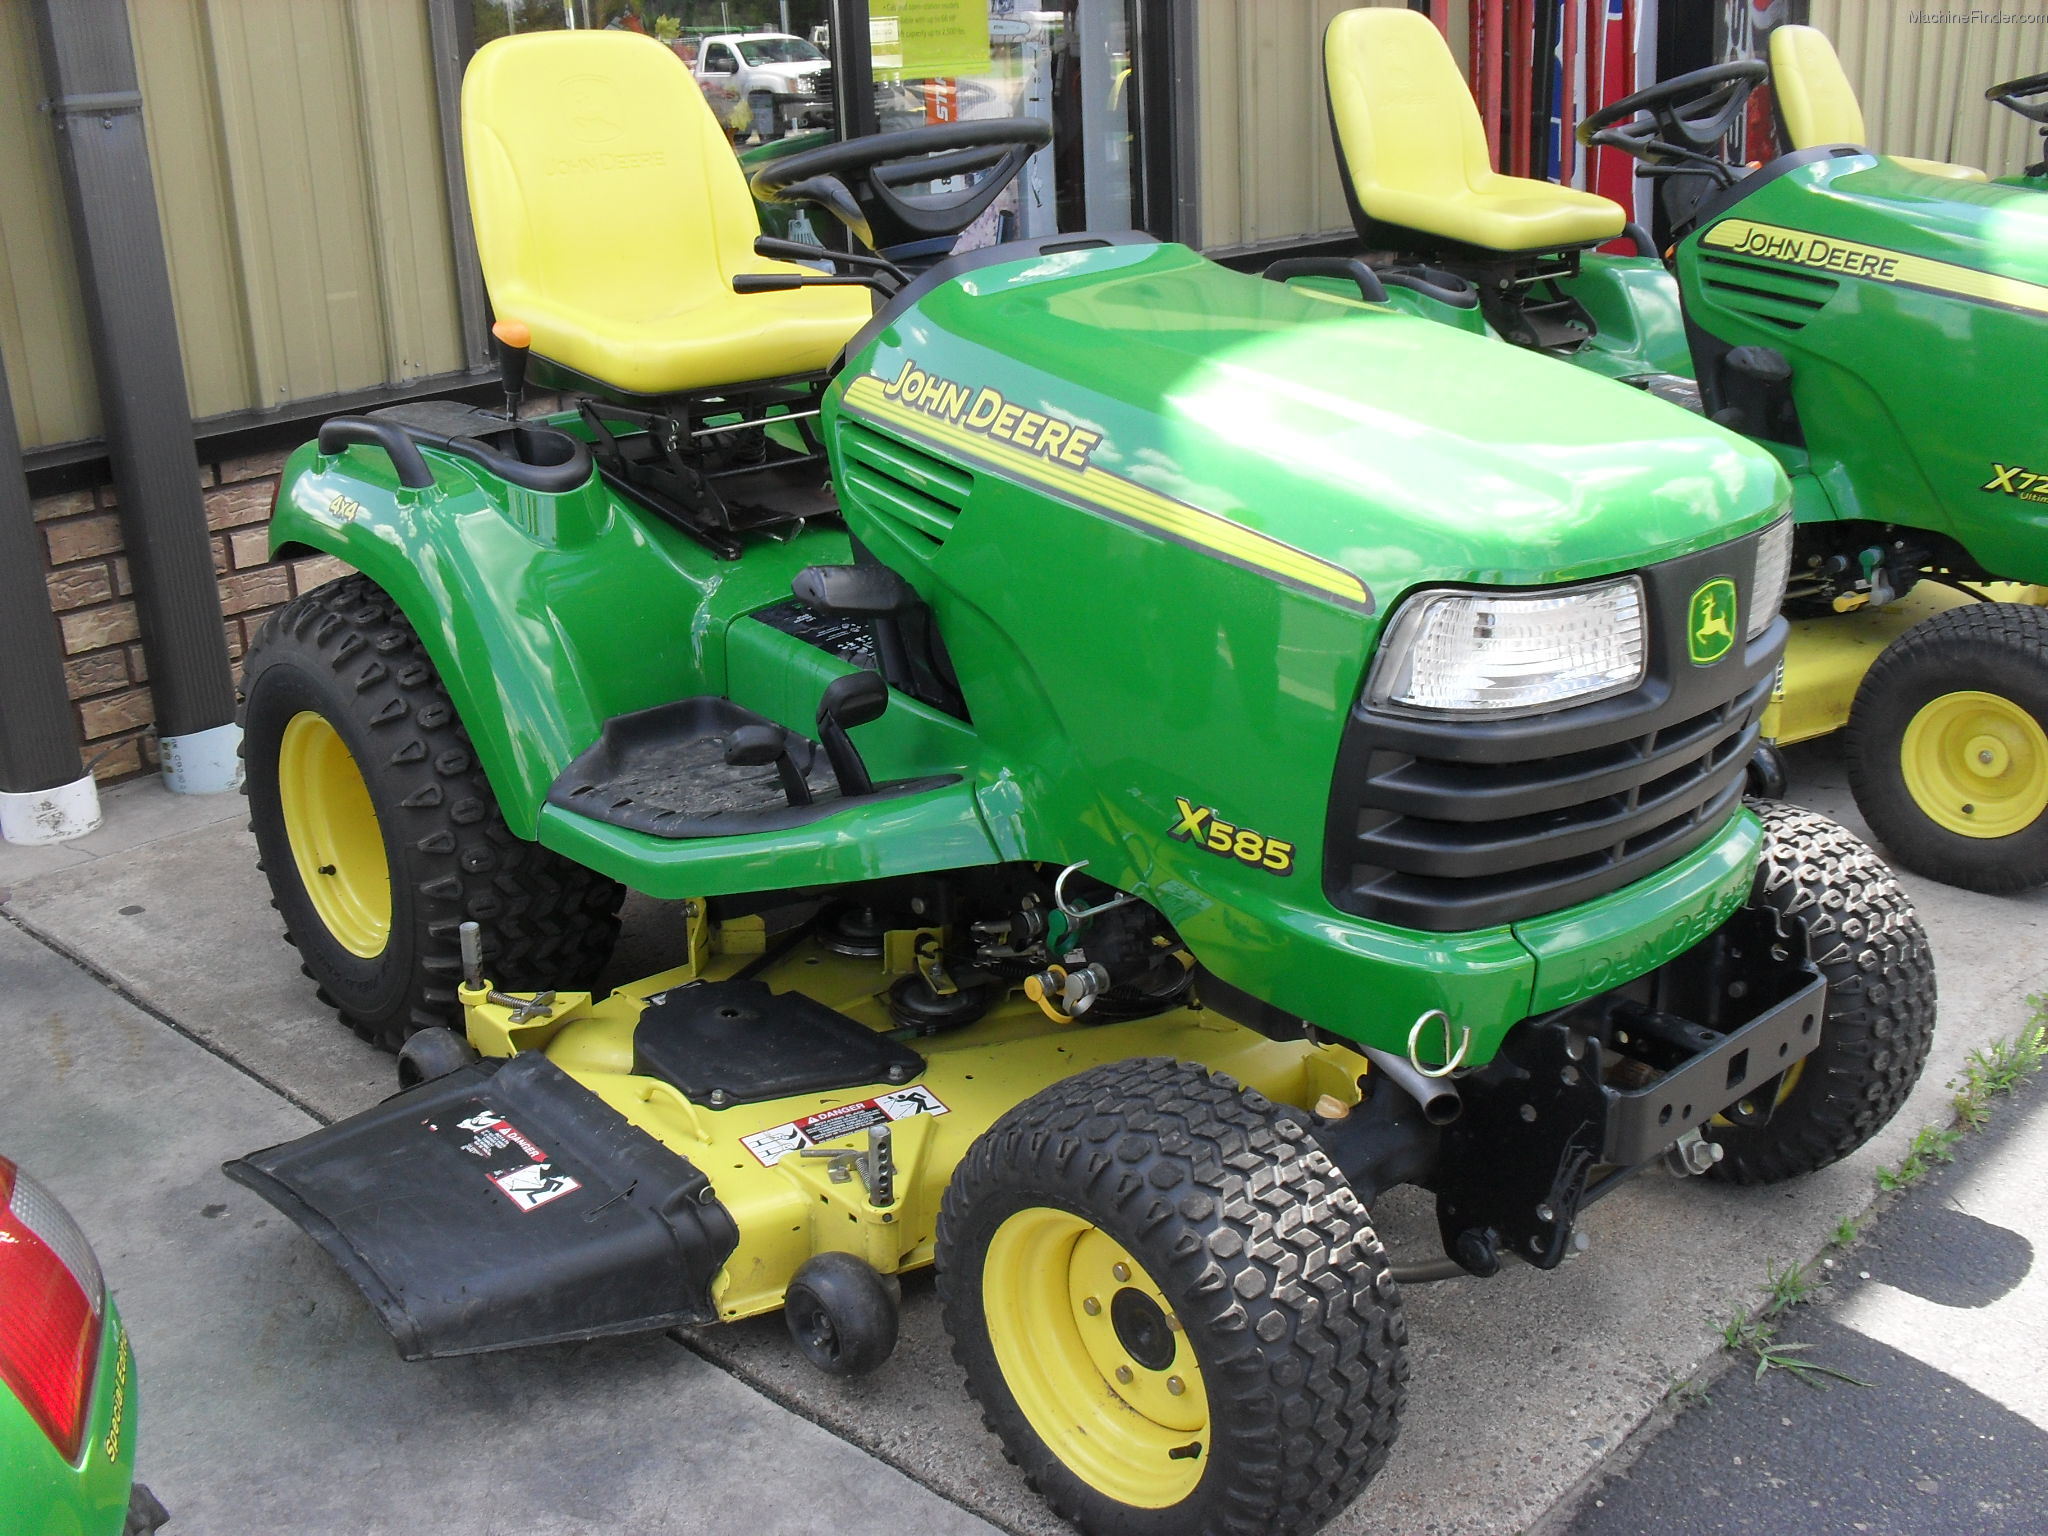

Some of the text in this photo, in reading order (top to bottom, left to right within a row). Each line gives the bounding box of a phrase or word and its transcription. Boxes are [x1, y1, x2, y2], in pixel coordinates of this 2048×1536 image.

[1734, 228, 1899, 278] JOHN DEERE
[884, 360, 1101, 471] JOHN DEERE
[1168, 797, 1295, 875] X585
[817, 1101, 866, 1122] DANGER
[507, 1131, 541, 1159] DANGER
[105, 1377, 124, 1464] Special
